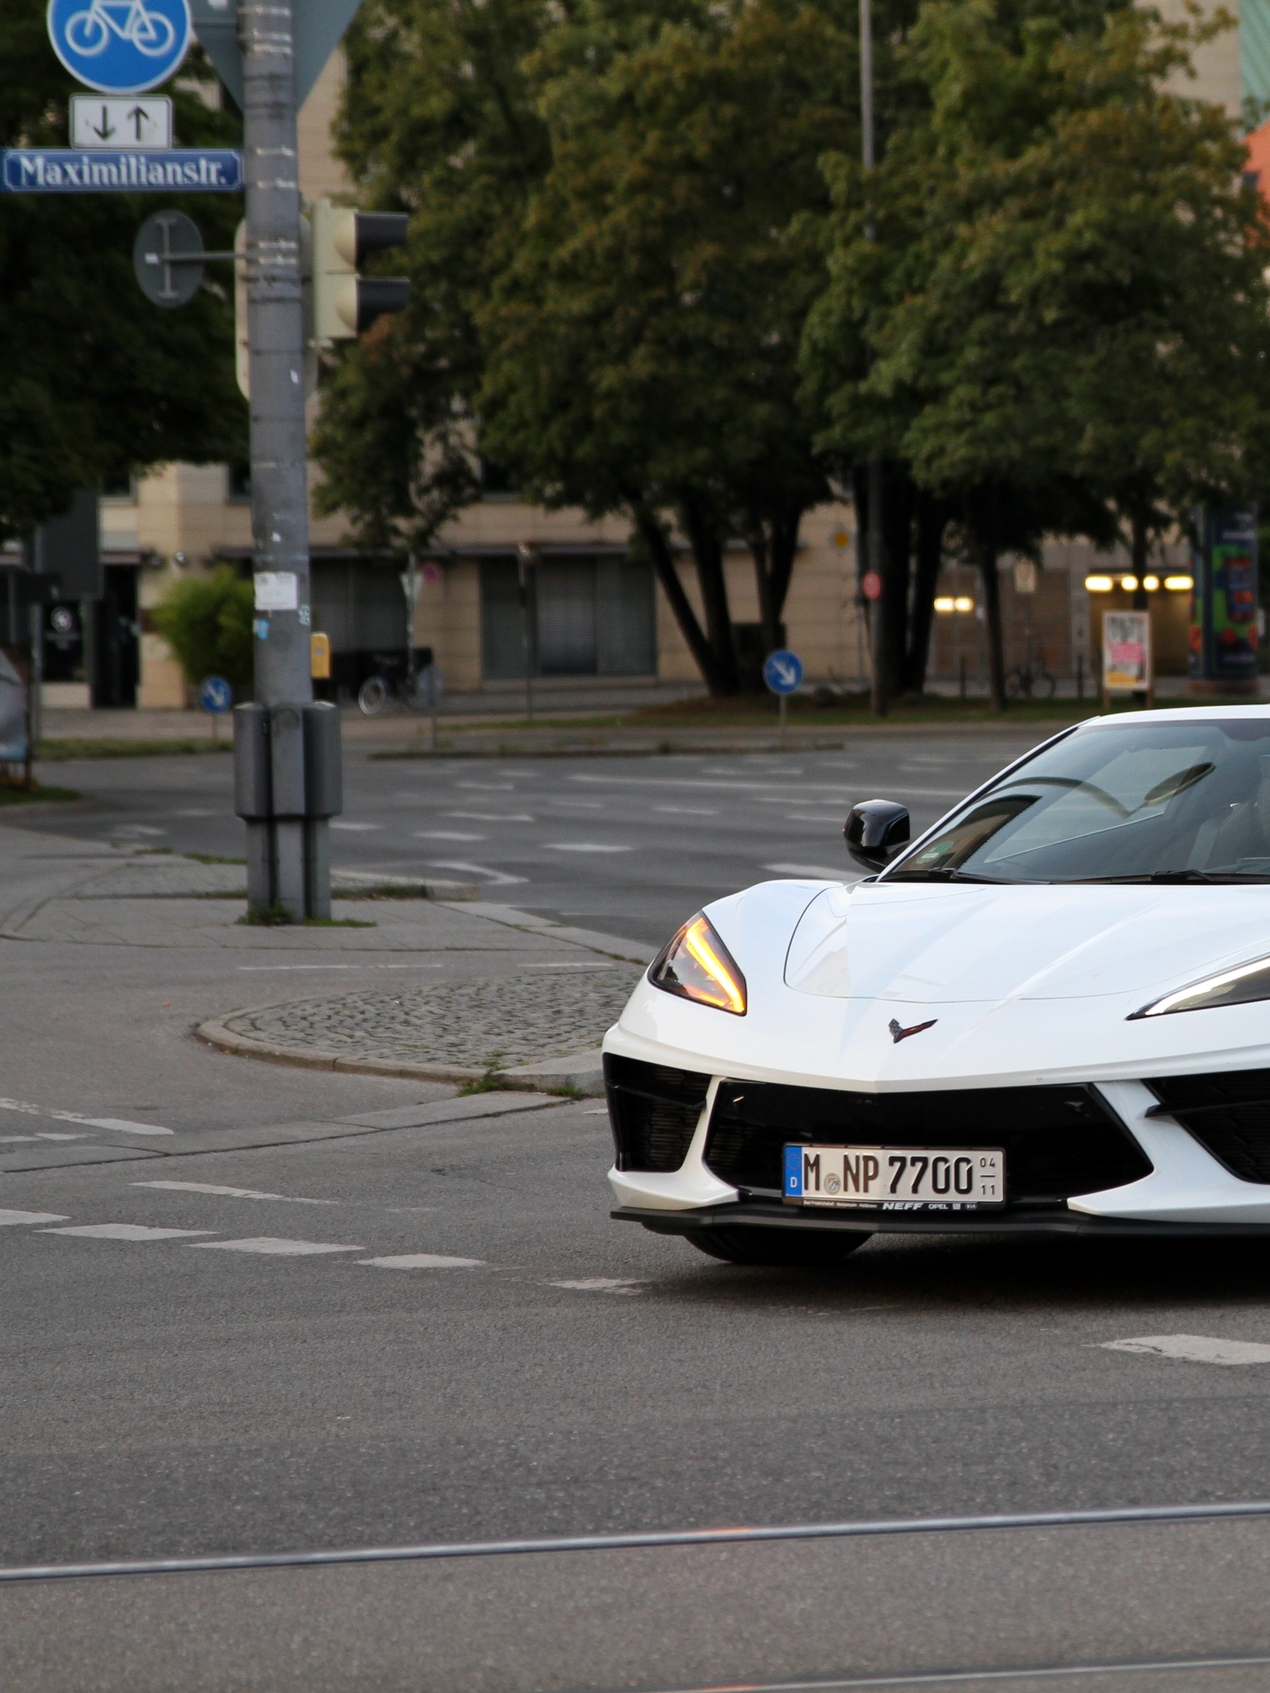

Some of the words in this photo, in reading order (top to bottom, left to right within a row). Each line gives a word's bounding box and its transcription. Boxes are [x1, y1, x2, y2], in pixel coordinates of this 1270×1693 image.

[20, 156, 227, 186] Maximilianstr.
[979, 1157, 996, 1168] 04
[803, 1153, 820, 1191] M
[843, 1154, 879, 1193] NP
[888, 1156, 973, 1194] 7700
[790, 1177, 798, 1188] D
[981, 1185, 996, 1196] 11
[882, 1202, 924, 1210] NEFF
